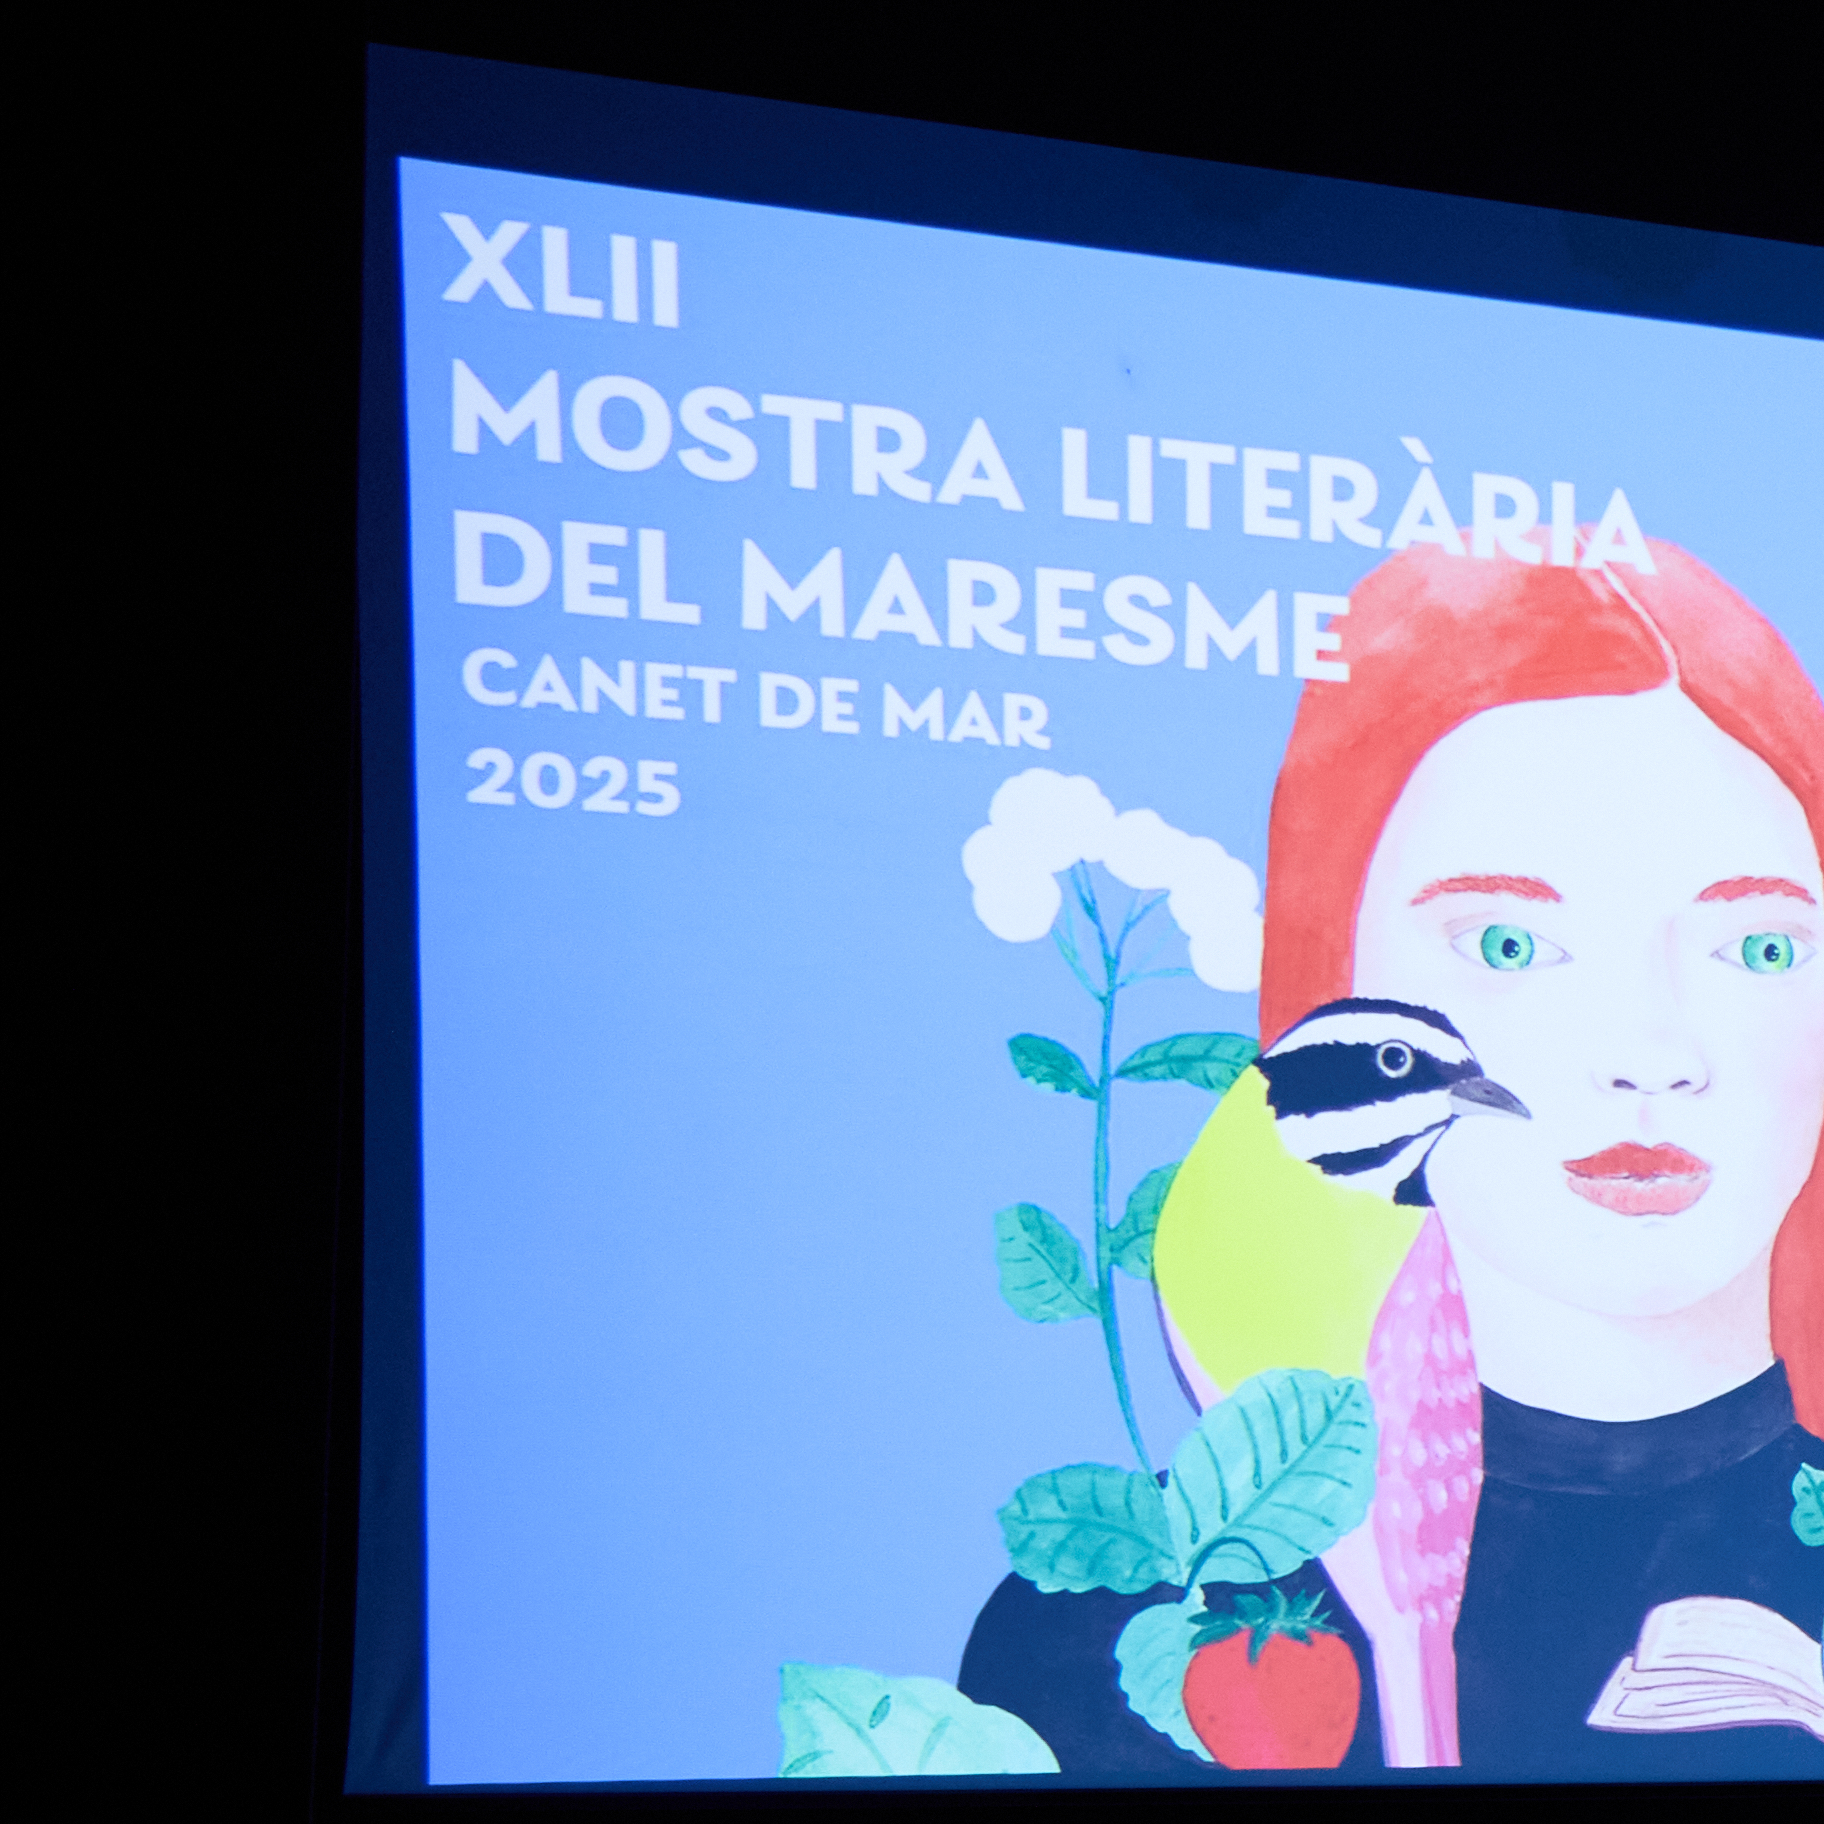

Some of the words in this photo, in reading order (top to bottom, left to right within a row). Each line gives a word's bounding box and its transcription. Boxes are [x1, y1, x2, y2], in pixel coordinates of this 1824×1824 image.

[440, 211, 682, 328] XLII
[451, 358, 1024, 513] MOSTRA
[1060, 427, 1657, 576] LITERÀRIA
[453, 510, 701, 626] DEL
[741, 538, 1350, 684] MARESME
[462, 647, 736, 723] CANET
[759, 672, 861, 735] DE
[883, 684, 1051, 752] MAR
[466, 746, 682, 818] 2025
